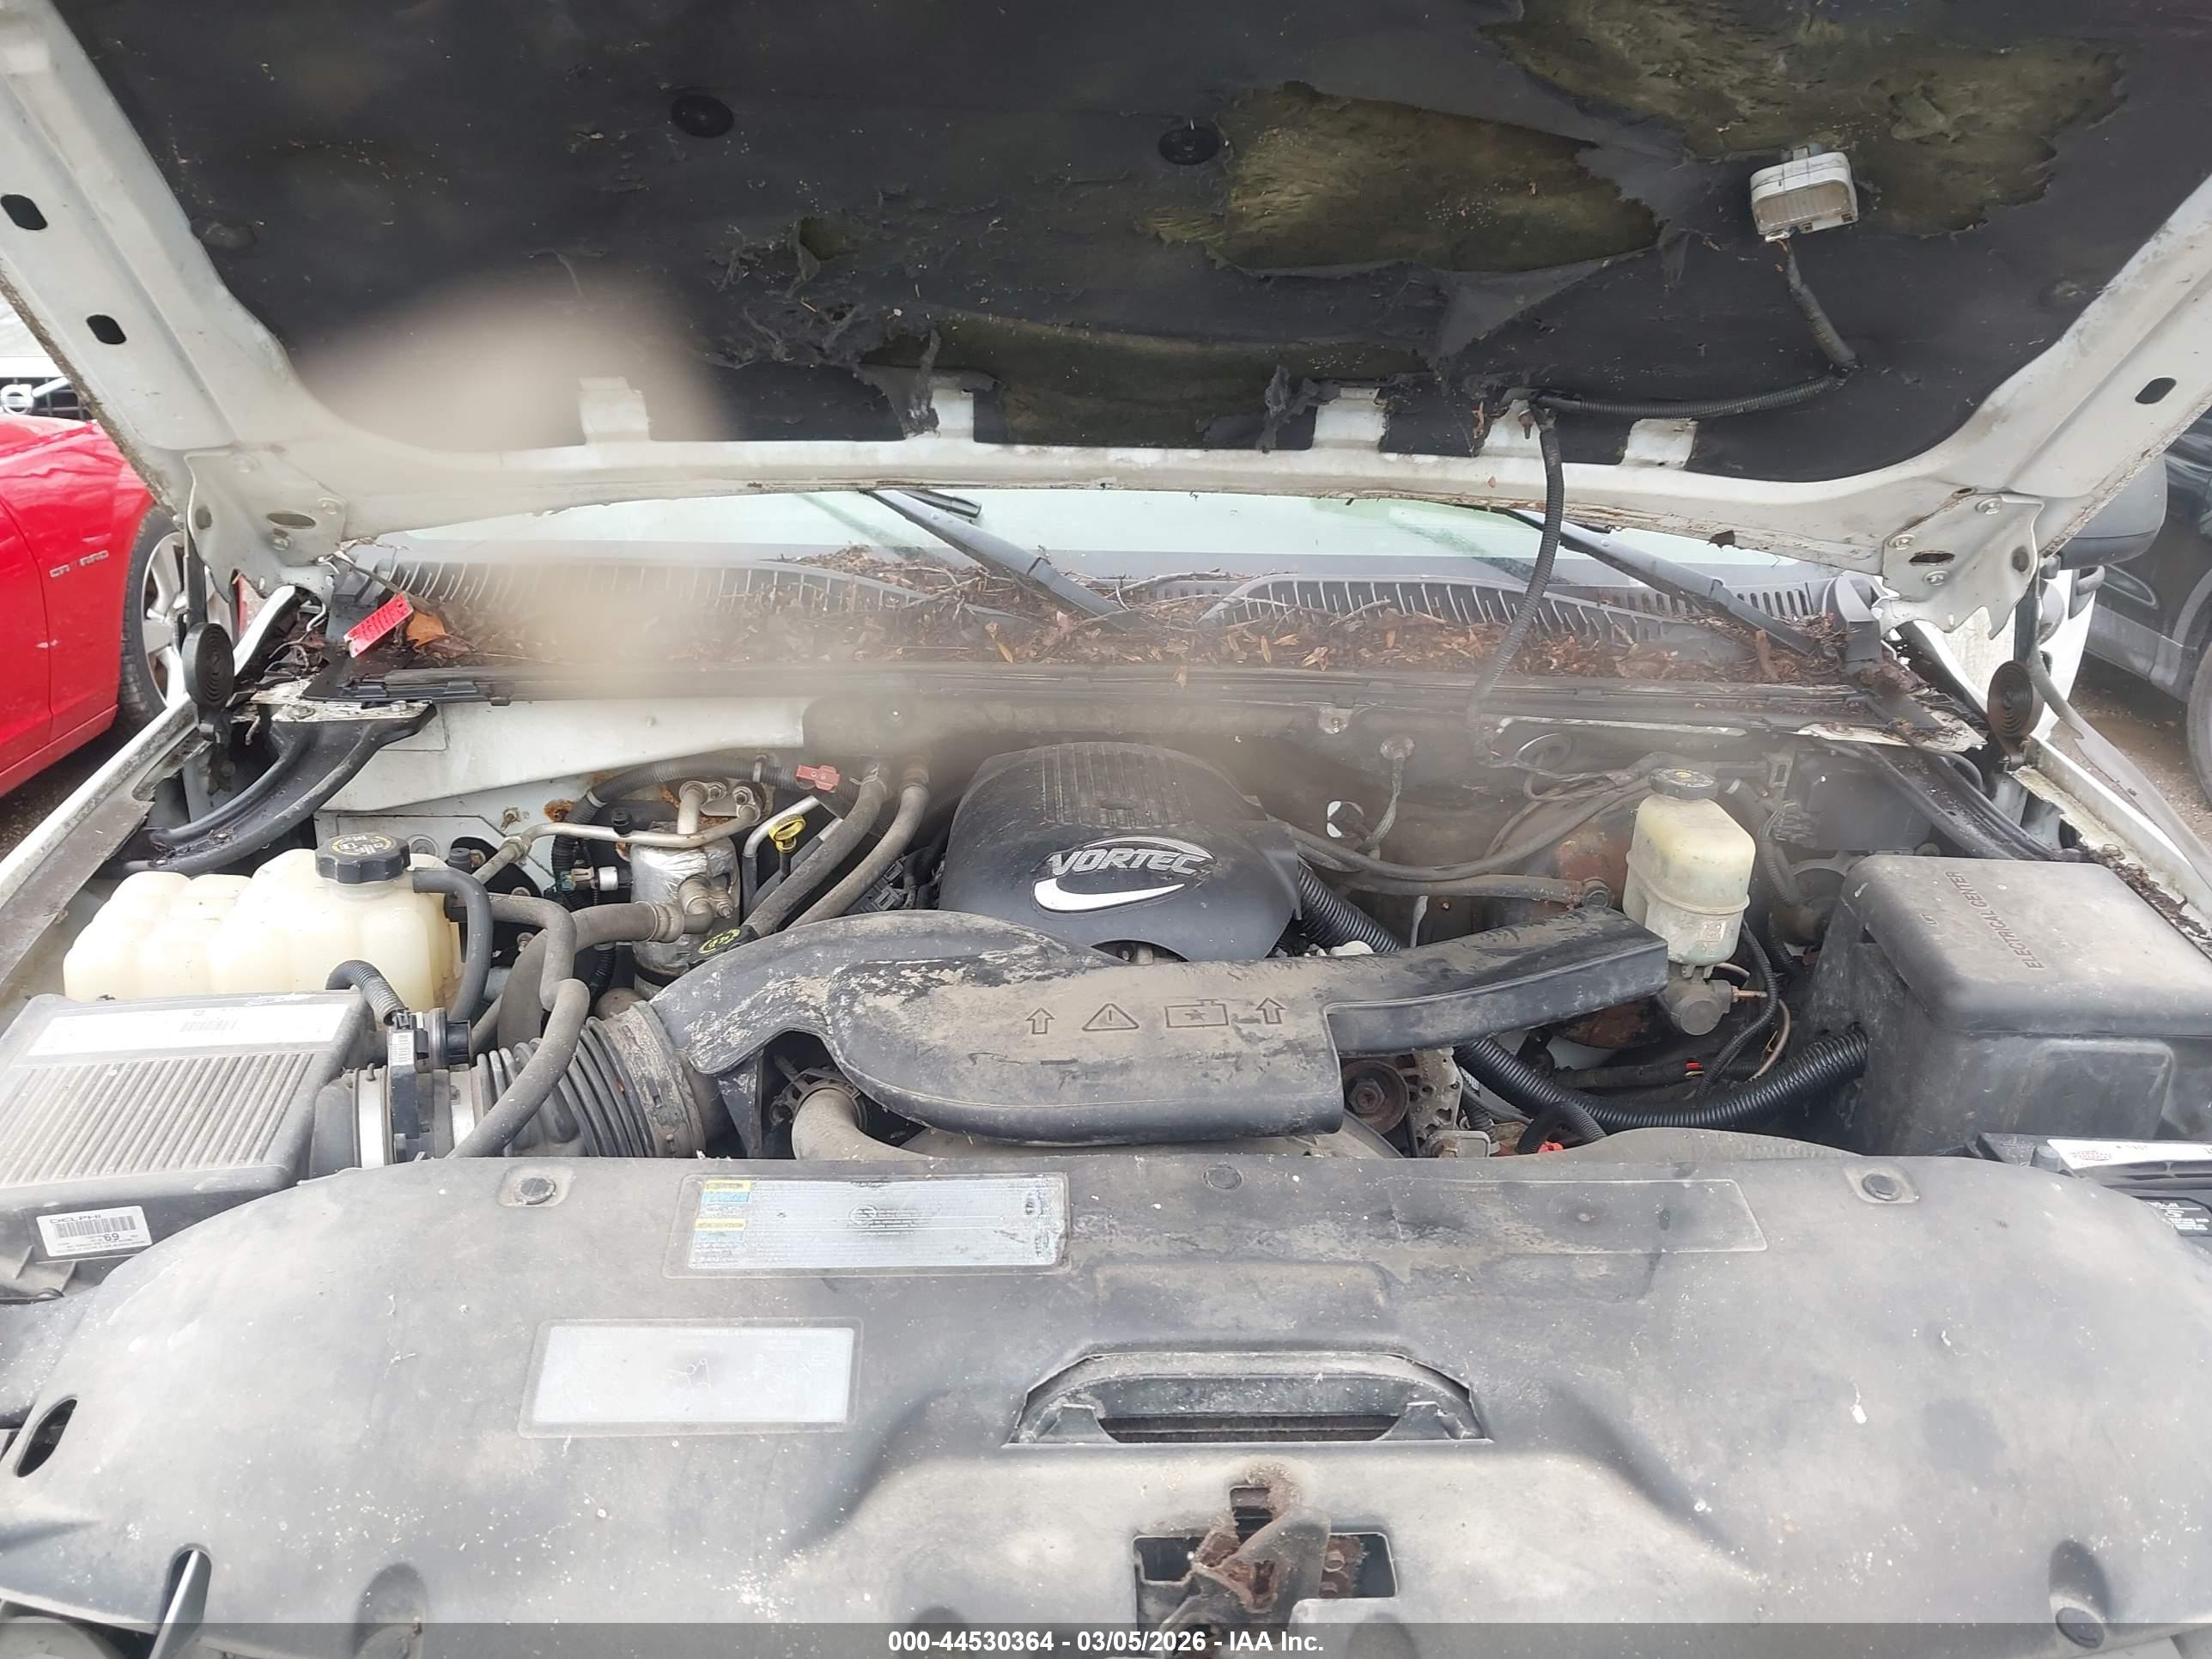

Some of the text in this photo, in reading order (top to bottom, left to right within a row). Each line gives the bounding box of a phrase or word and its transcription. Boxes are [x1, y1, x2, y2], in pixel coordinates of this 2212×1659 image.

[1045, 848, 1206, 876] VORTEC
[1944, 870, 2045, 969] ELECTRICAL CENTER
[103, 1232, 120, 1242] 69
